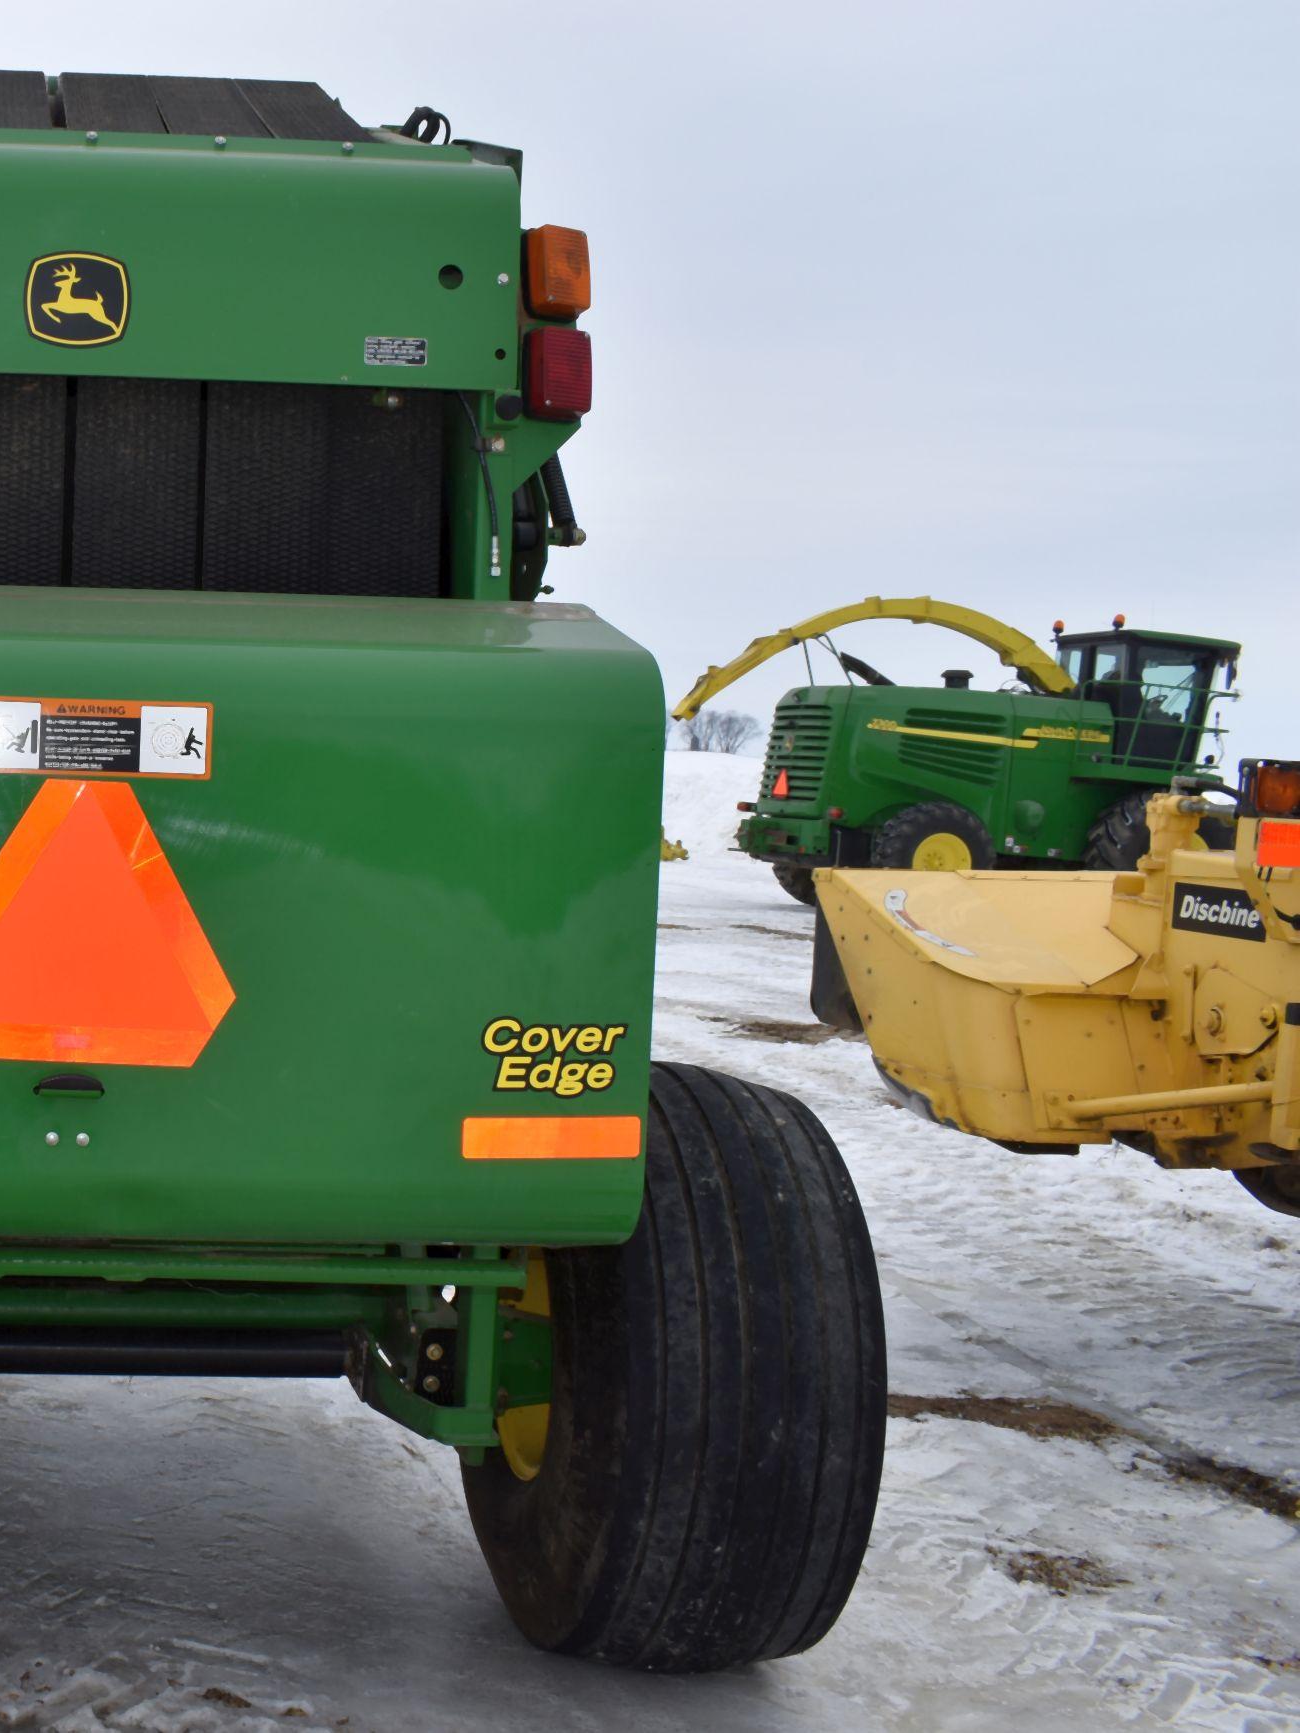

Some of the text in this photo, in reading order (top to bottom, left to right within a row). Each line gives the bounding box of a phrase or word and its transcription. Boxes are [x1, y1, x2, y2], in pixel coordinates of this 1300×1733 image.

[67, 704, 126, 715] WARNING
[1180, 894, 1261, 929] Discbine
[483, 1017, 626, 1054] Cover
[496, 1055, 614, 1097] Edge
